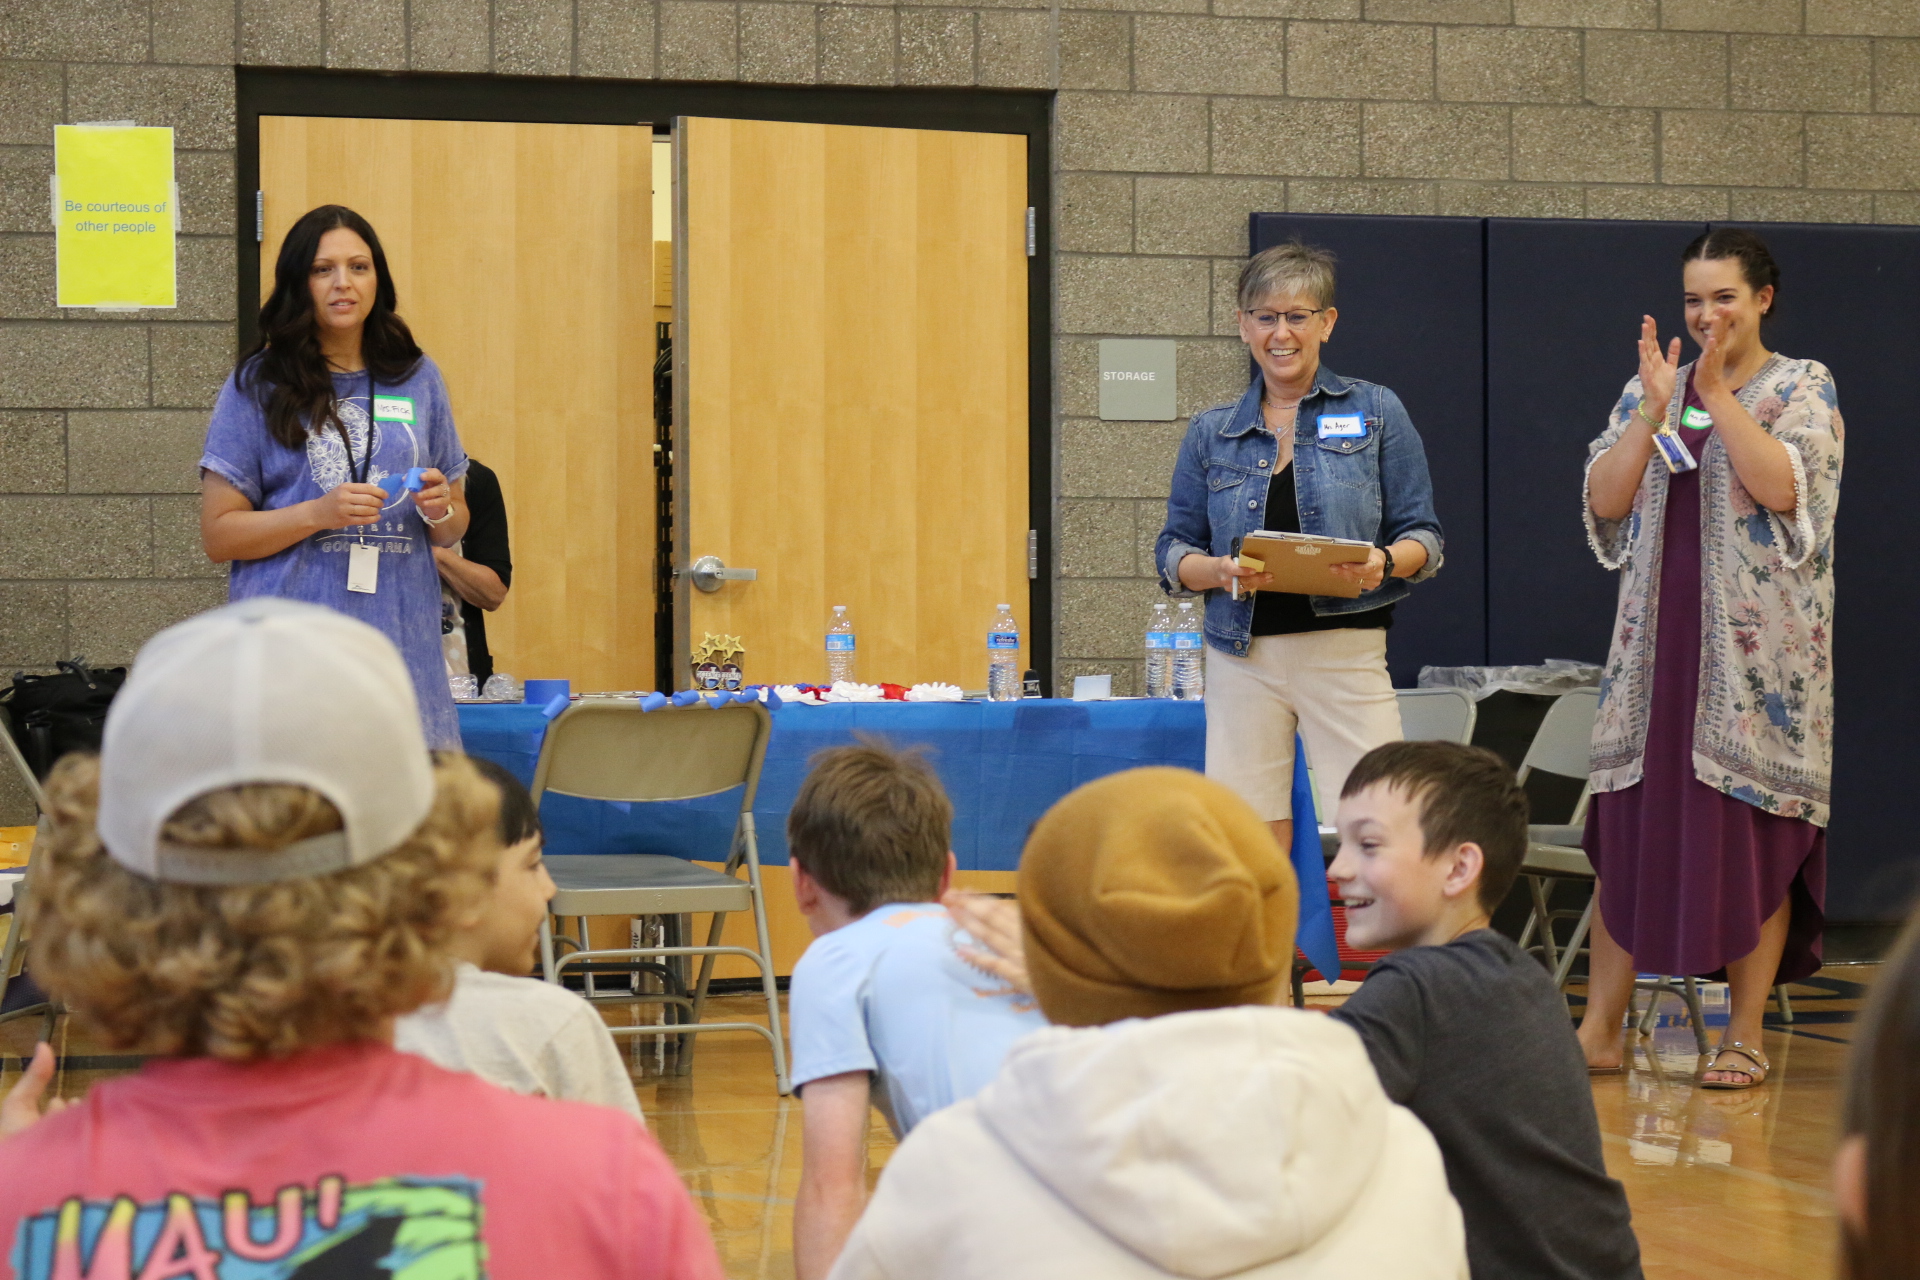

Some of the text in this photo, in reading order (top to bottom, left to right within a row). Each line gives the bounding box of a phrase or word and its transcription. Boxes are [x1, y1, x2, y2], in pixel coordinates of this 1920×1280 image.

[65, 200, 167, 213] Be courteous of
[76, 220, 156, 234] other people
[1103, 371, 1156, 381] STORAGE
[322, 541, 358, 553] GOO
